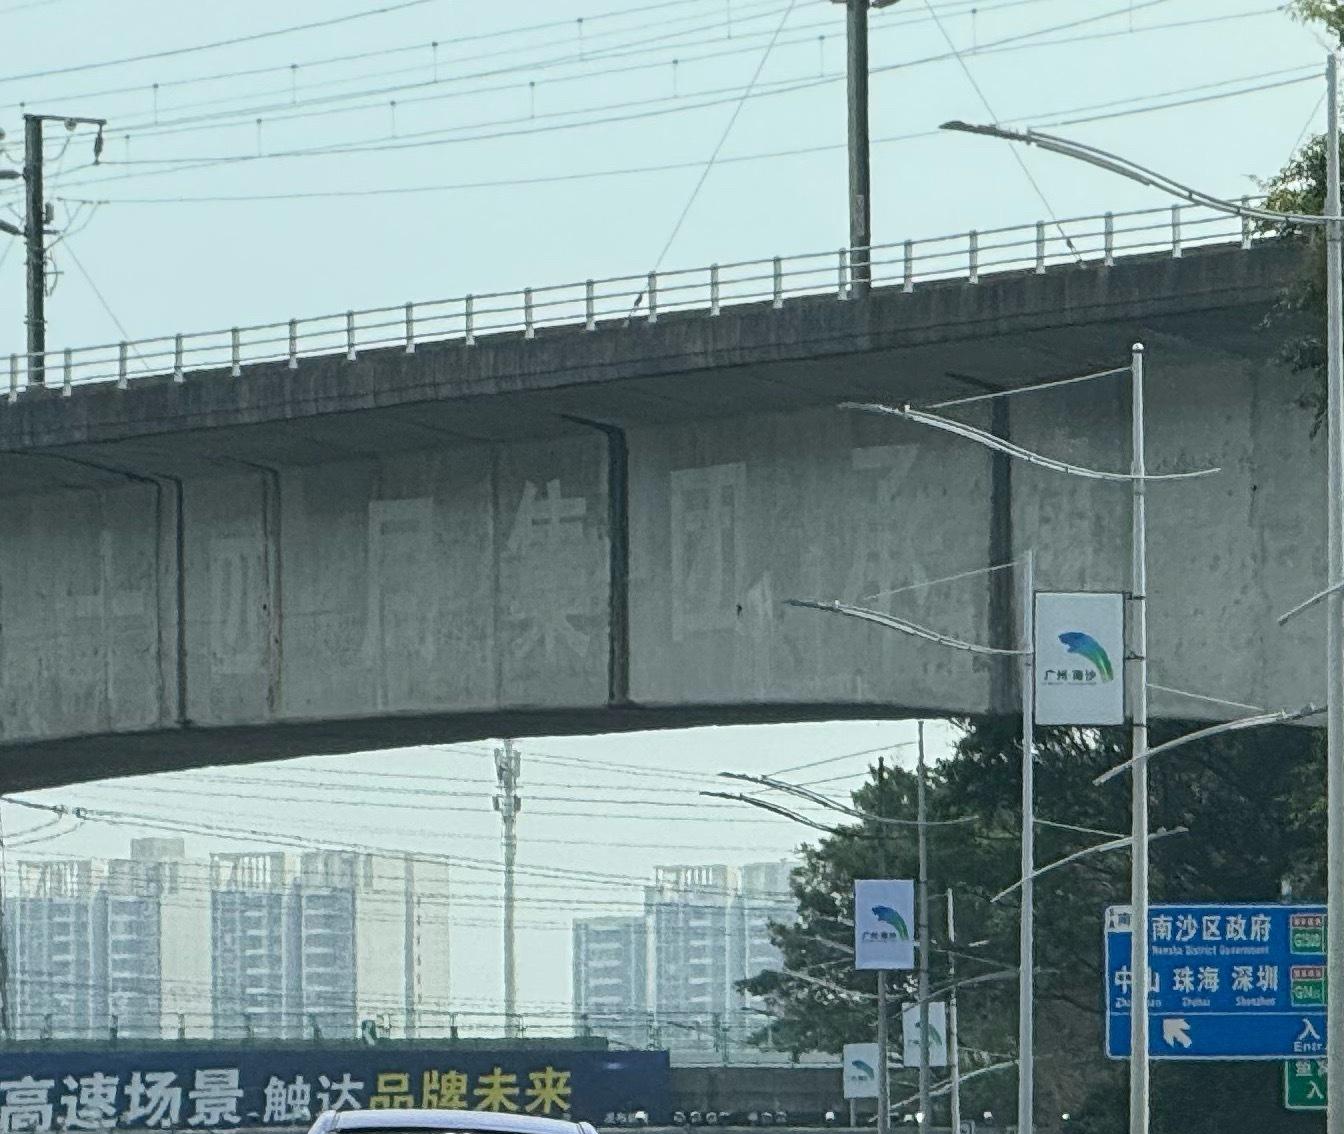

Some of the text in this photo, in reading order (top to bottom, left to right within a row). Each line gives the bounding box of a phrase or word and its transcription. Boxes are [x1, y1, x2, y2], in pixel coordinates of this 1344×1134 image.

[1151, 913, 1272, 943] 南沙区政府
[1172, 964, 1220, 993] 珠海
[1231, 964, 1279, 992] 深圳
[0, 1066, 573, 1134] 高速场景 触达品牌未来
